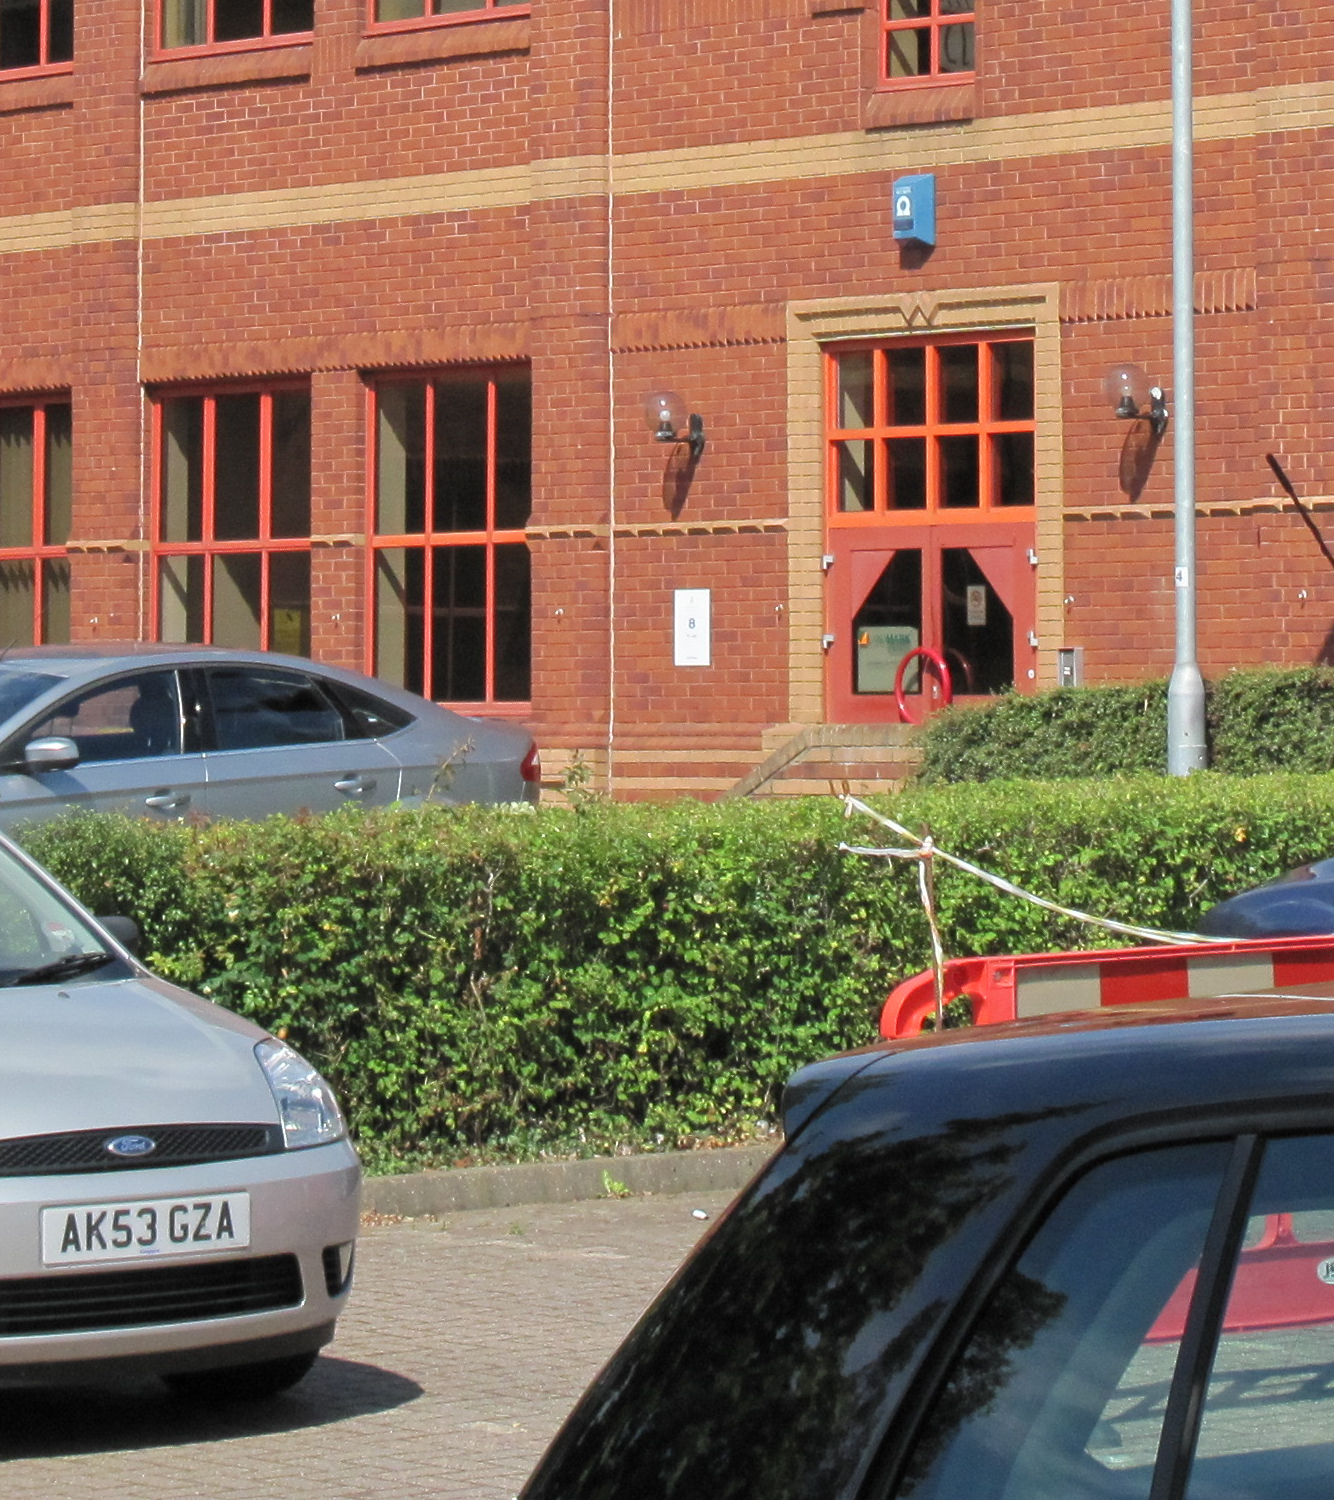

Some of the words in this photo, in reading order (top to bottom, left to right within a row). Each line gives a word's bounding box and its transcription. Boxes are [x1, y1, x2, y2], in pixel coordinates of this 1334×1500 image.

[688, 617, 696, 630] 8
[61, 1207, 158, 1253] AK53
[169, 1200, 235, 1244] GZA
